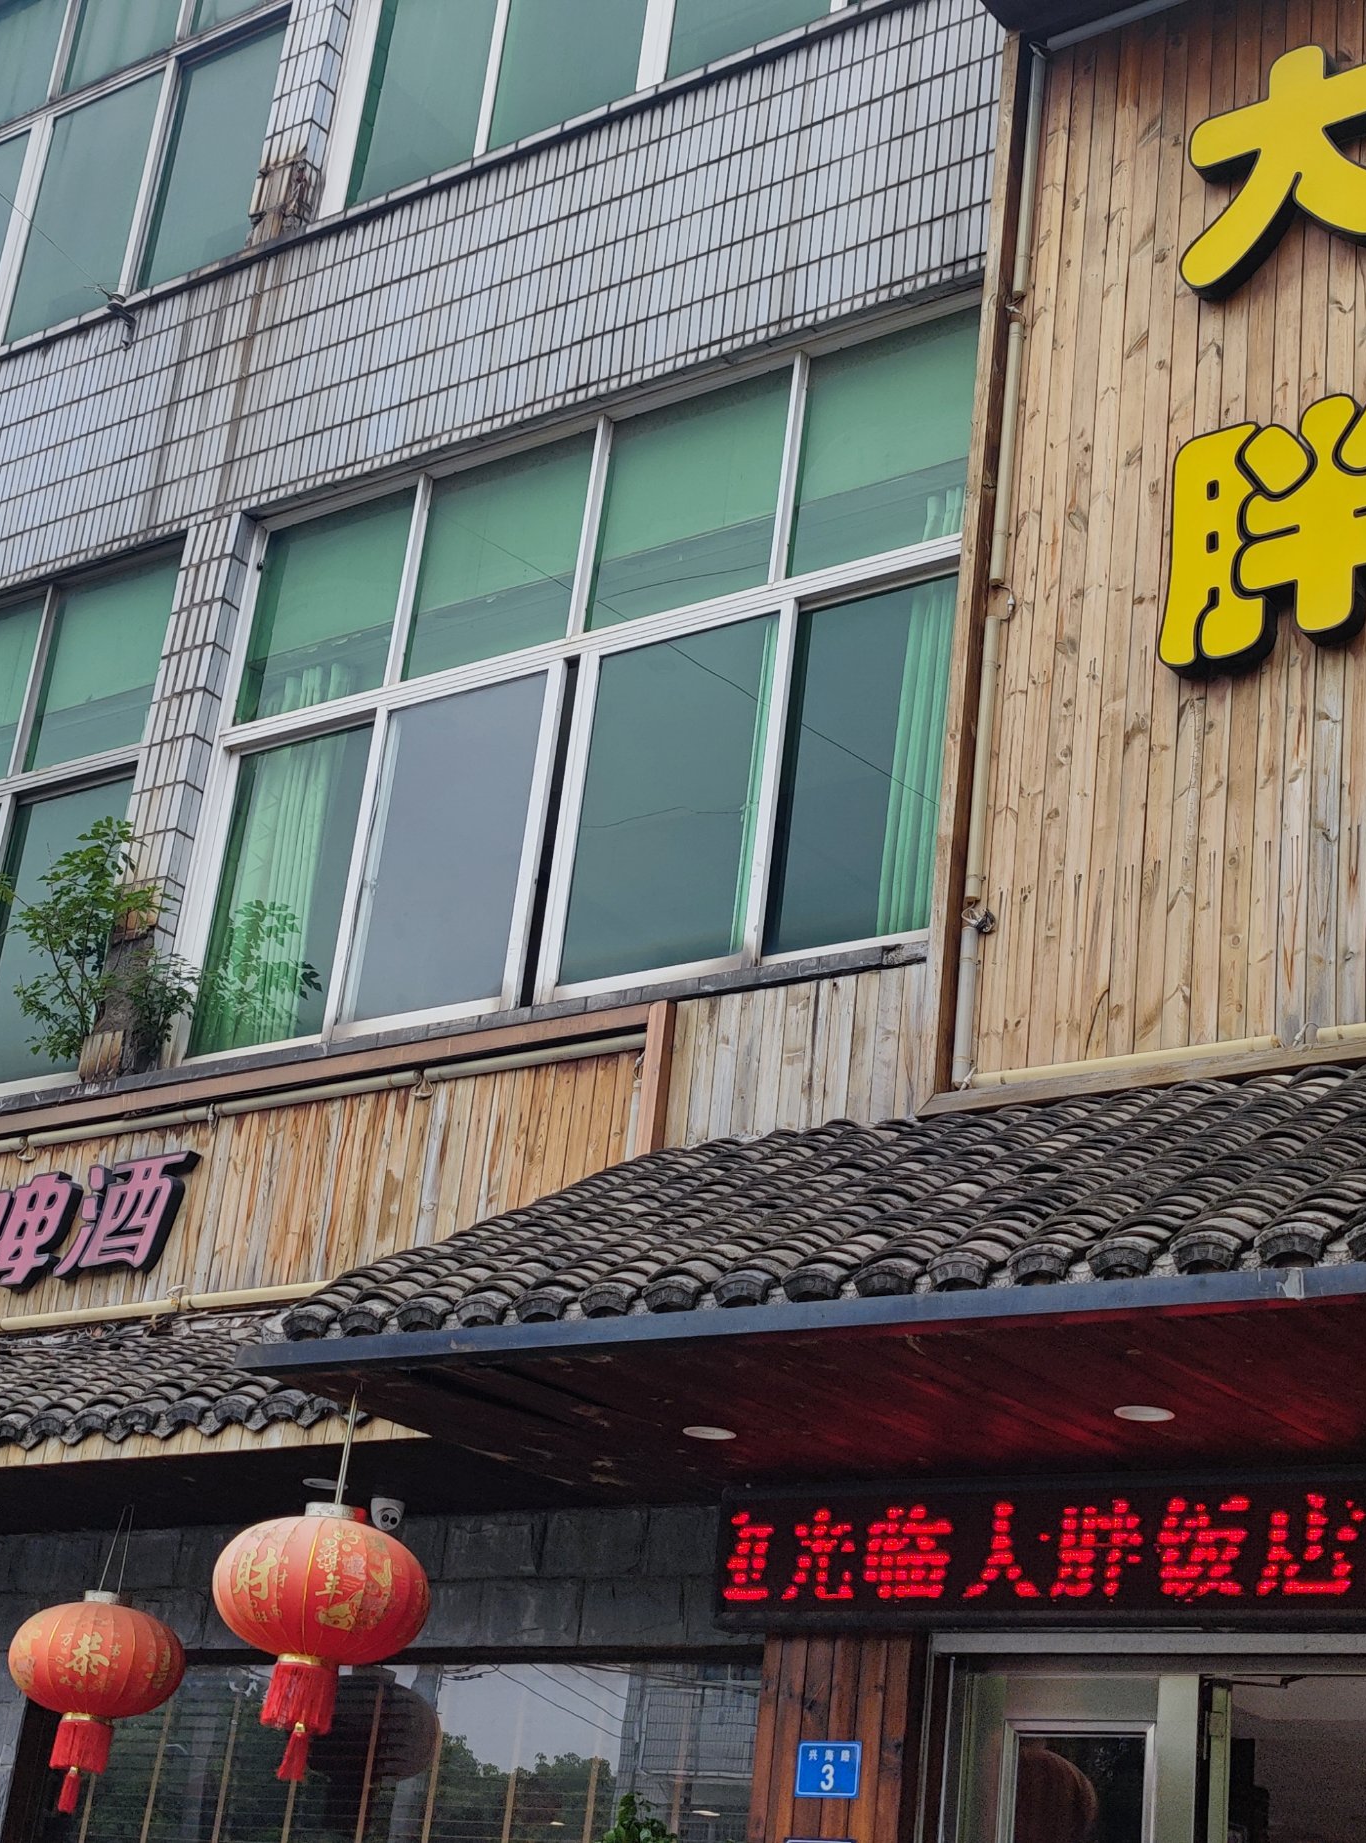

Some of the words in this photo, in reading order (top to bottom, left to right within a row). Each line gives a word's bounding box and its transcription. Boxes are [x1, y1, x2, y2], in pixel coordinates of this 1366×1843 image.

[808, 1749, 851, 1763] 兴海路
[820, 1763, 835, 1792] 3
